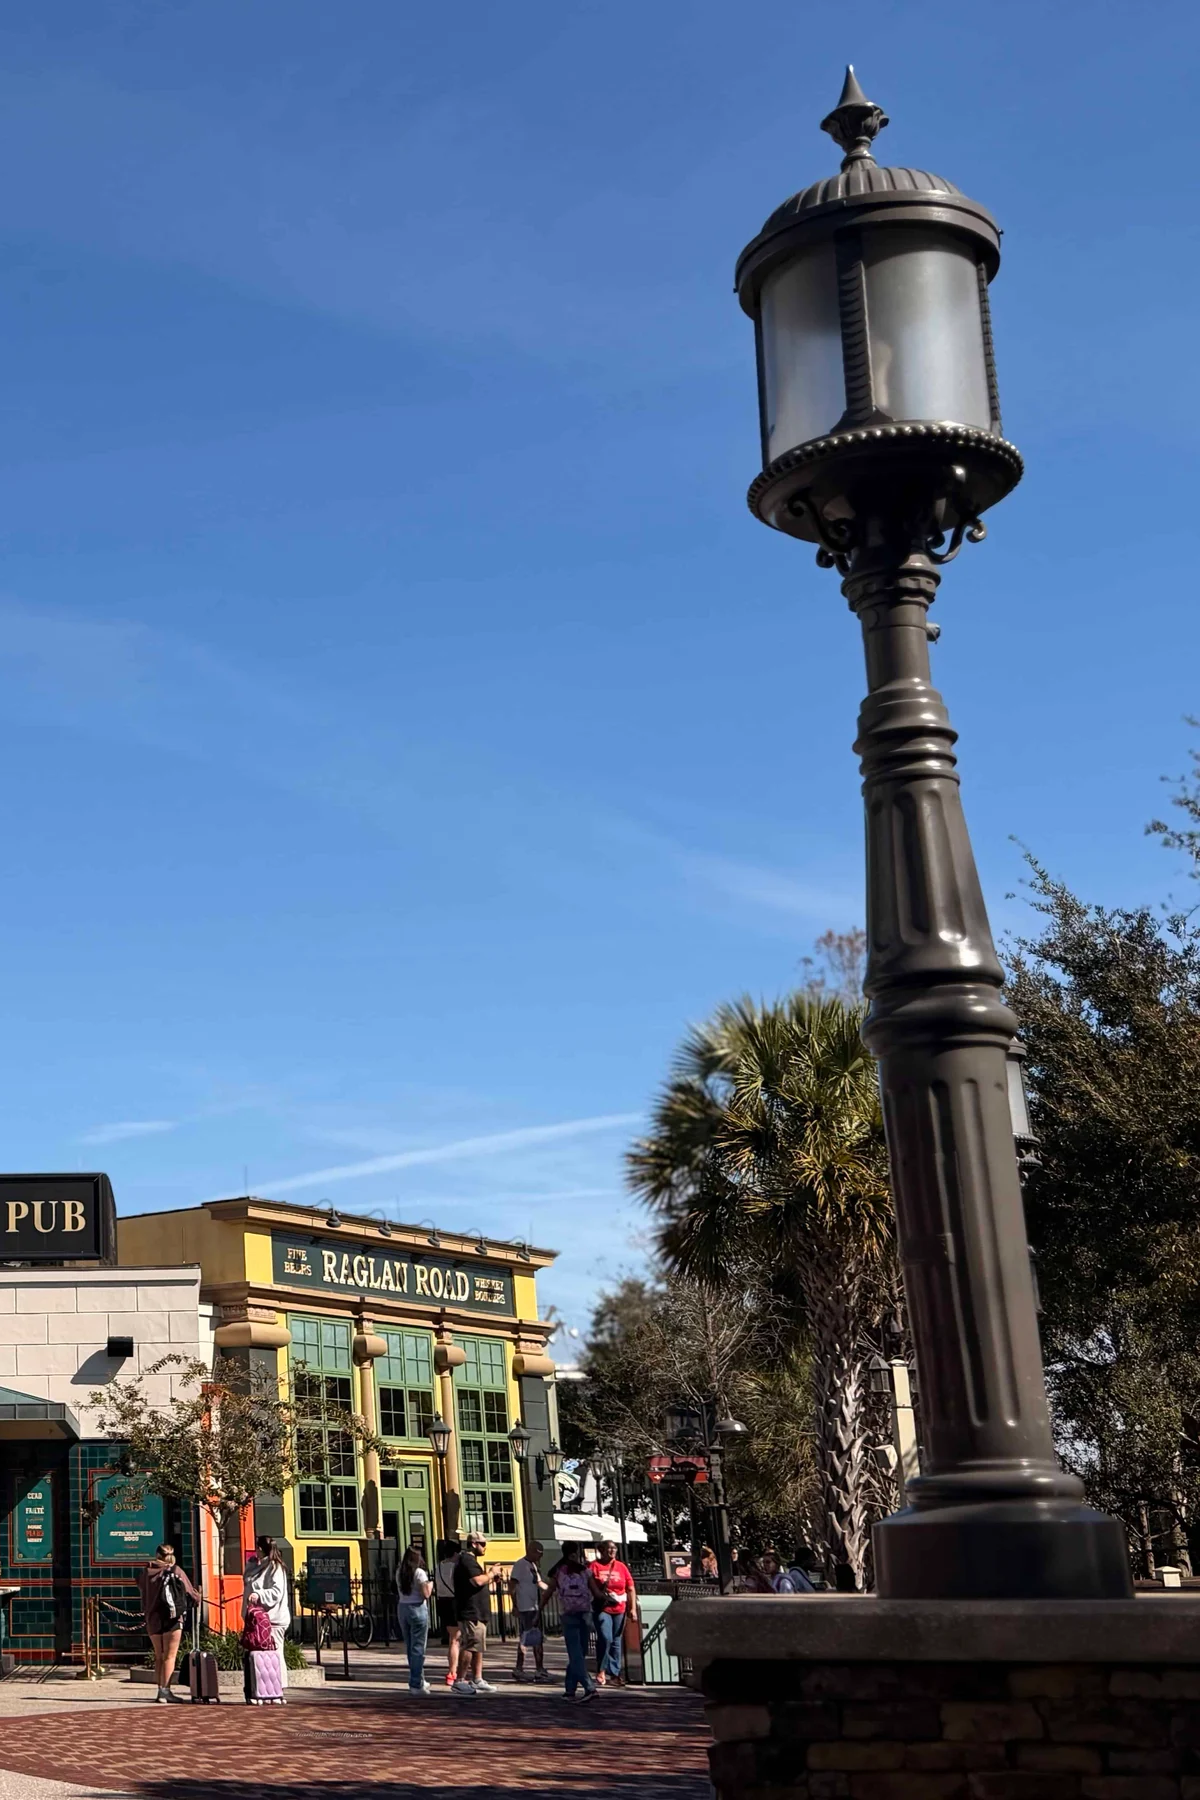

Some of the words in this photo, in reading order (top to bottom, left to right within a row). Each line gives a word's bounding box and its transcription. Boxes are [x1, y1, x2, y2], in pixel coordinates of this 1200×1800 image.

[5, 1200, 86, 1233] PUB
[287, 1248, 307, 1262] FINE
[284, 1261, 312, 1276] BEERS
[322, 1250, 408, 1293] RAGLAN
[414, 1264, 470, 1302] ROAD
